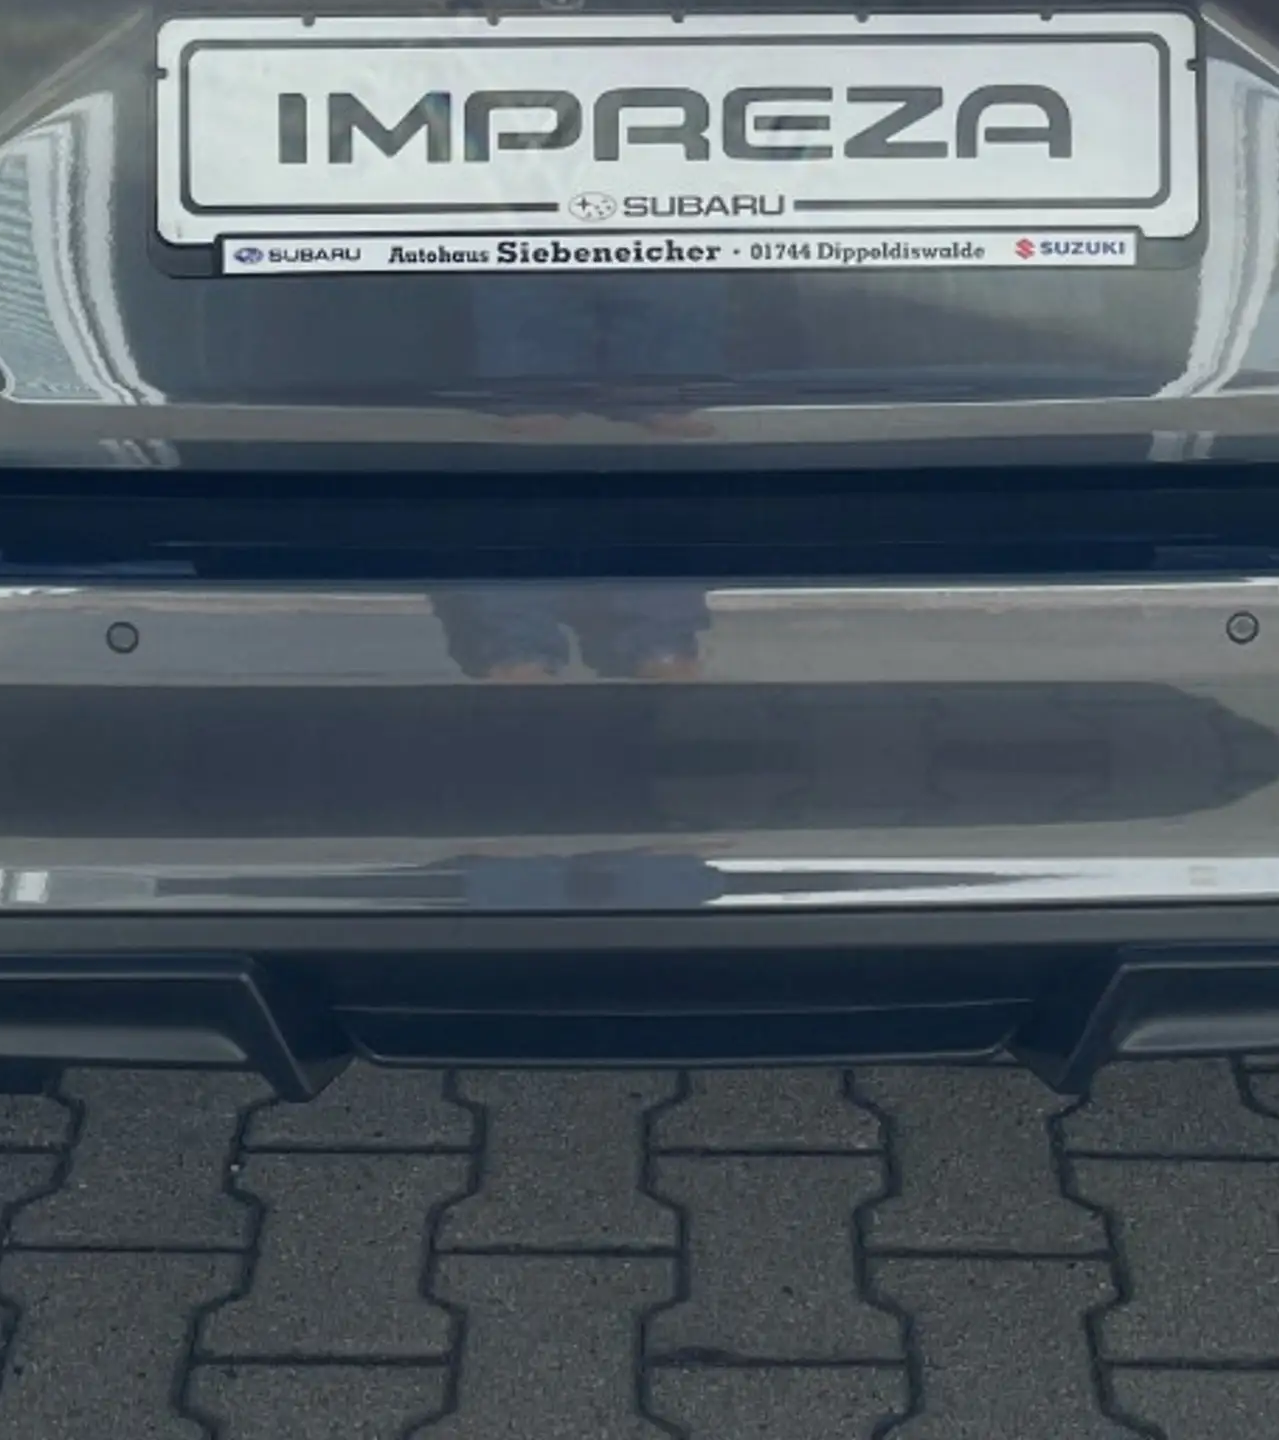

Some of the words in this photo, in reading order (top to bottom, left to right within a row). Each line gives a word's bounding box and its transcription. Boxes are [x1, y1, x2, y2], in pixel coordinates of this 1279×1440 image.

[277, 84, 1073, 164] IMPREZA
[622, 195, 786, 218] SUBARU
[267, 247, 362, 262] SUBARU
[387, 244, 490, 264] Autohaus
[496, 240, 721, 264] Siebeneicher
[749, 242, 812, 261] 01744
[819, 241, 986, 264] Dippoldiswalde
[1039, 240, 1126, 256] SUZUKI
